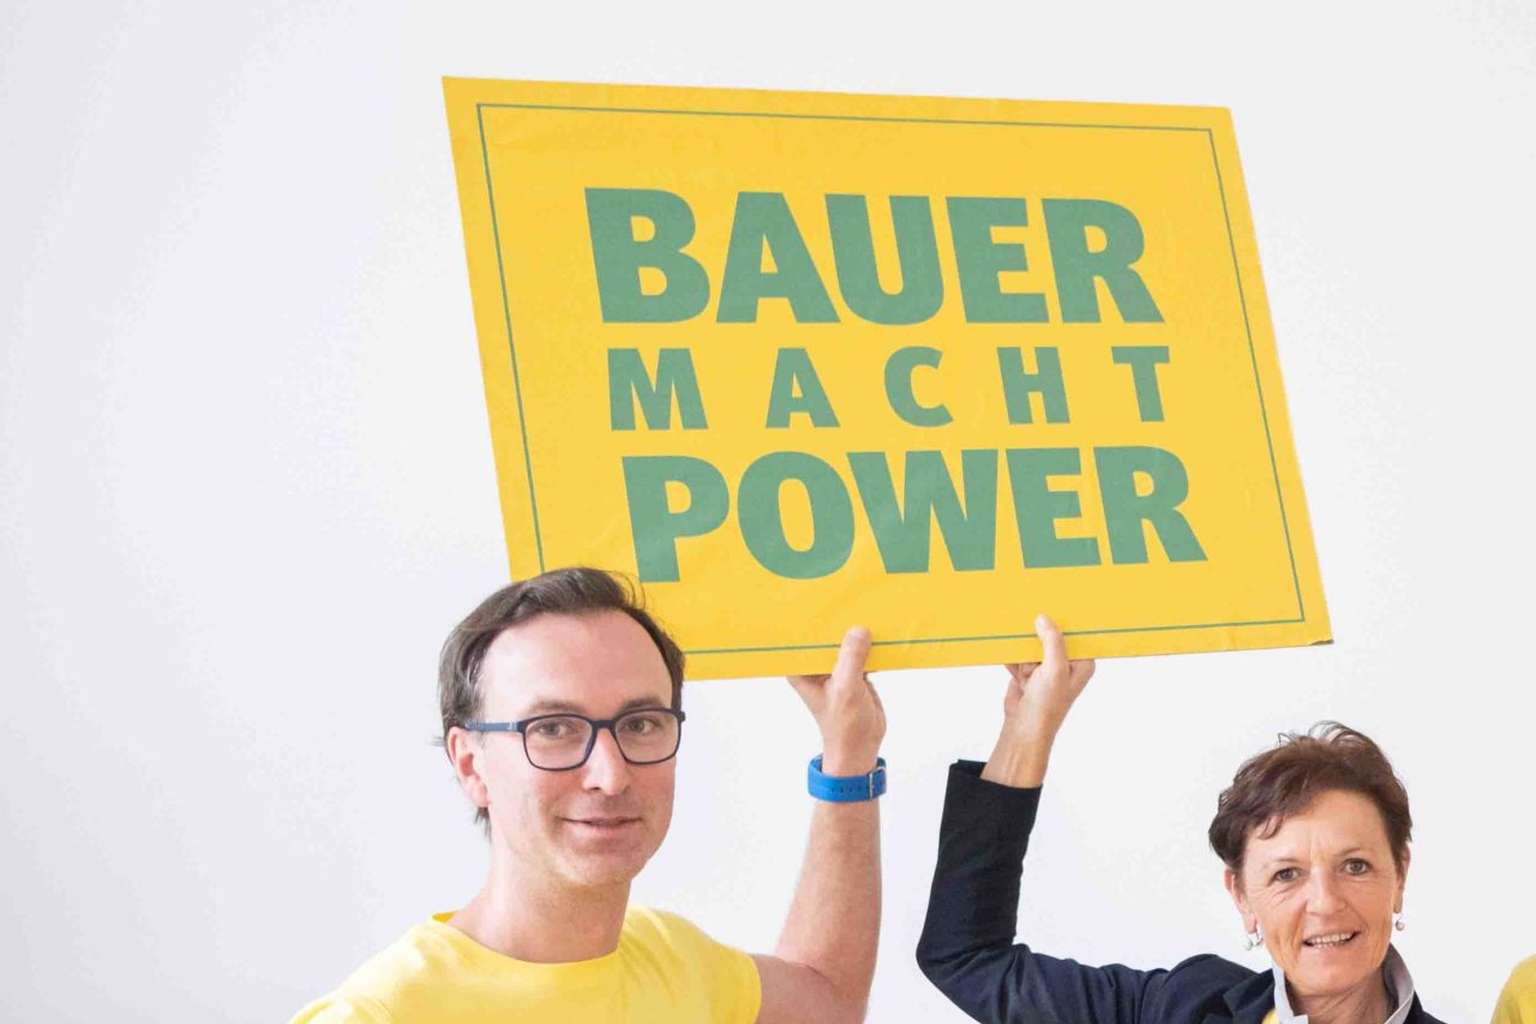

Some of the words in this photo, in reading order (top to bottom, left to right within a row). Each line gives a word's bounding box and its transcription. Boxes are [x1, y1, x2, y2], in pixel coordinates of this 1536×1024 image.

[583, 187, 1164, 325] BAUER
[607, 345, 1170, 432] MACHT
[622, 445, 1208, 585] POWER
